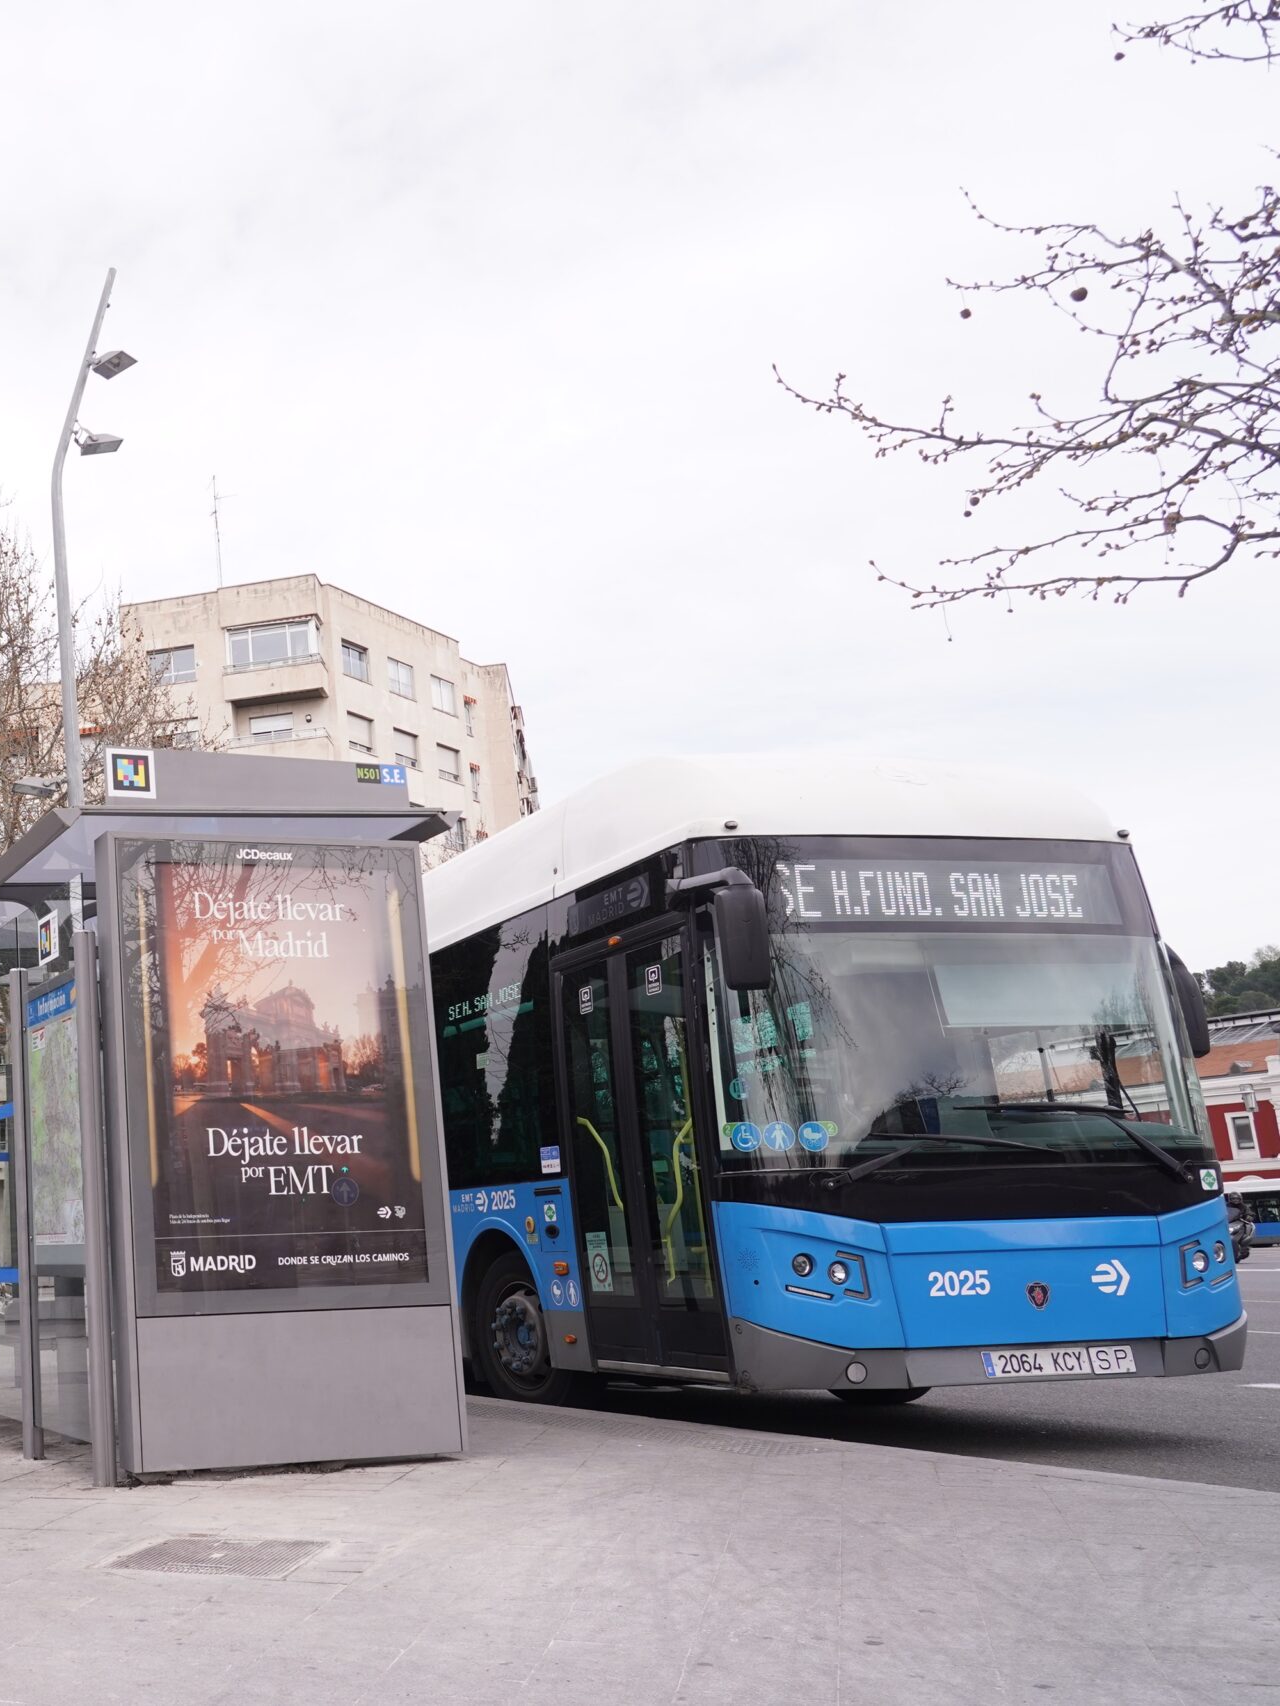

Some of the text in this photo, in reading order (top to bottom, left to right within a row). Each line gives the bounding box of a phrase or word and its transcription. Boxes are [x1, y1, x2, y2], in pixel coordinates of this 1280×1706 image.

[357, 767, 380, 780] N501
[382, 768, 405, 783] S.E.
[236, 848, 293, 861] JCDecaux
[603, 887, 624, 906] EMT
[949, 872, 1005, 918] SAN
[1016, 873, 1083, 918] JOSE
[192, 891, 345, 928] Déjate llevar
[587, 901, 625, 926] MADRID
[212, 929, 329, 958] por Madrid
[474, 992, 493, 1012] SAN
[495, 982, 521, 1005] JOSE
[206, 1126, 363, 1165] Déjate llevar
[241, 1165, 334, 1196] por EMT
[461, 1193, 473, 1202] EMT
[491, 1189, 516, 1211] 2025
[190, 1254, 257, 1274] MADRID
[278, 1252, 410, 1266] DONDE SE CRUZAN LOS CAMINOS
[927, 1270, 991, 1297] 2025
[998, 1351, 1083, 1374] 2064 KCY
